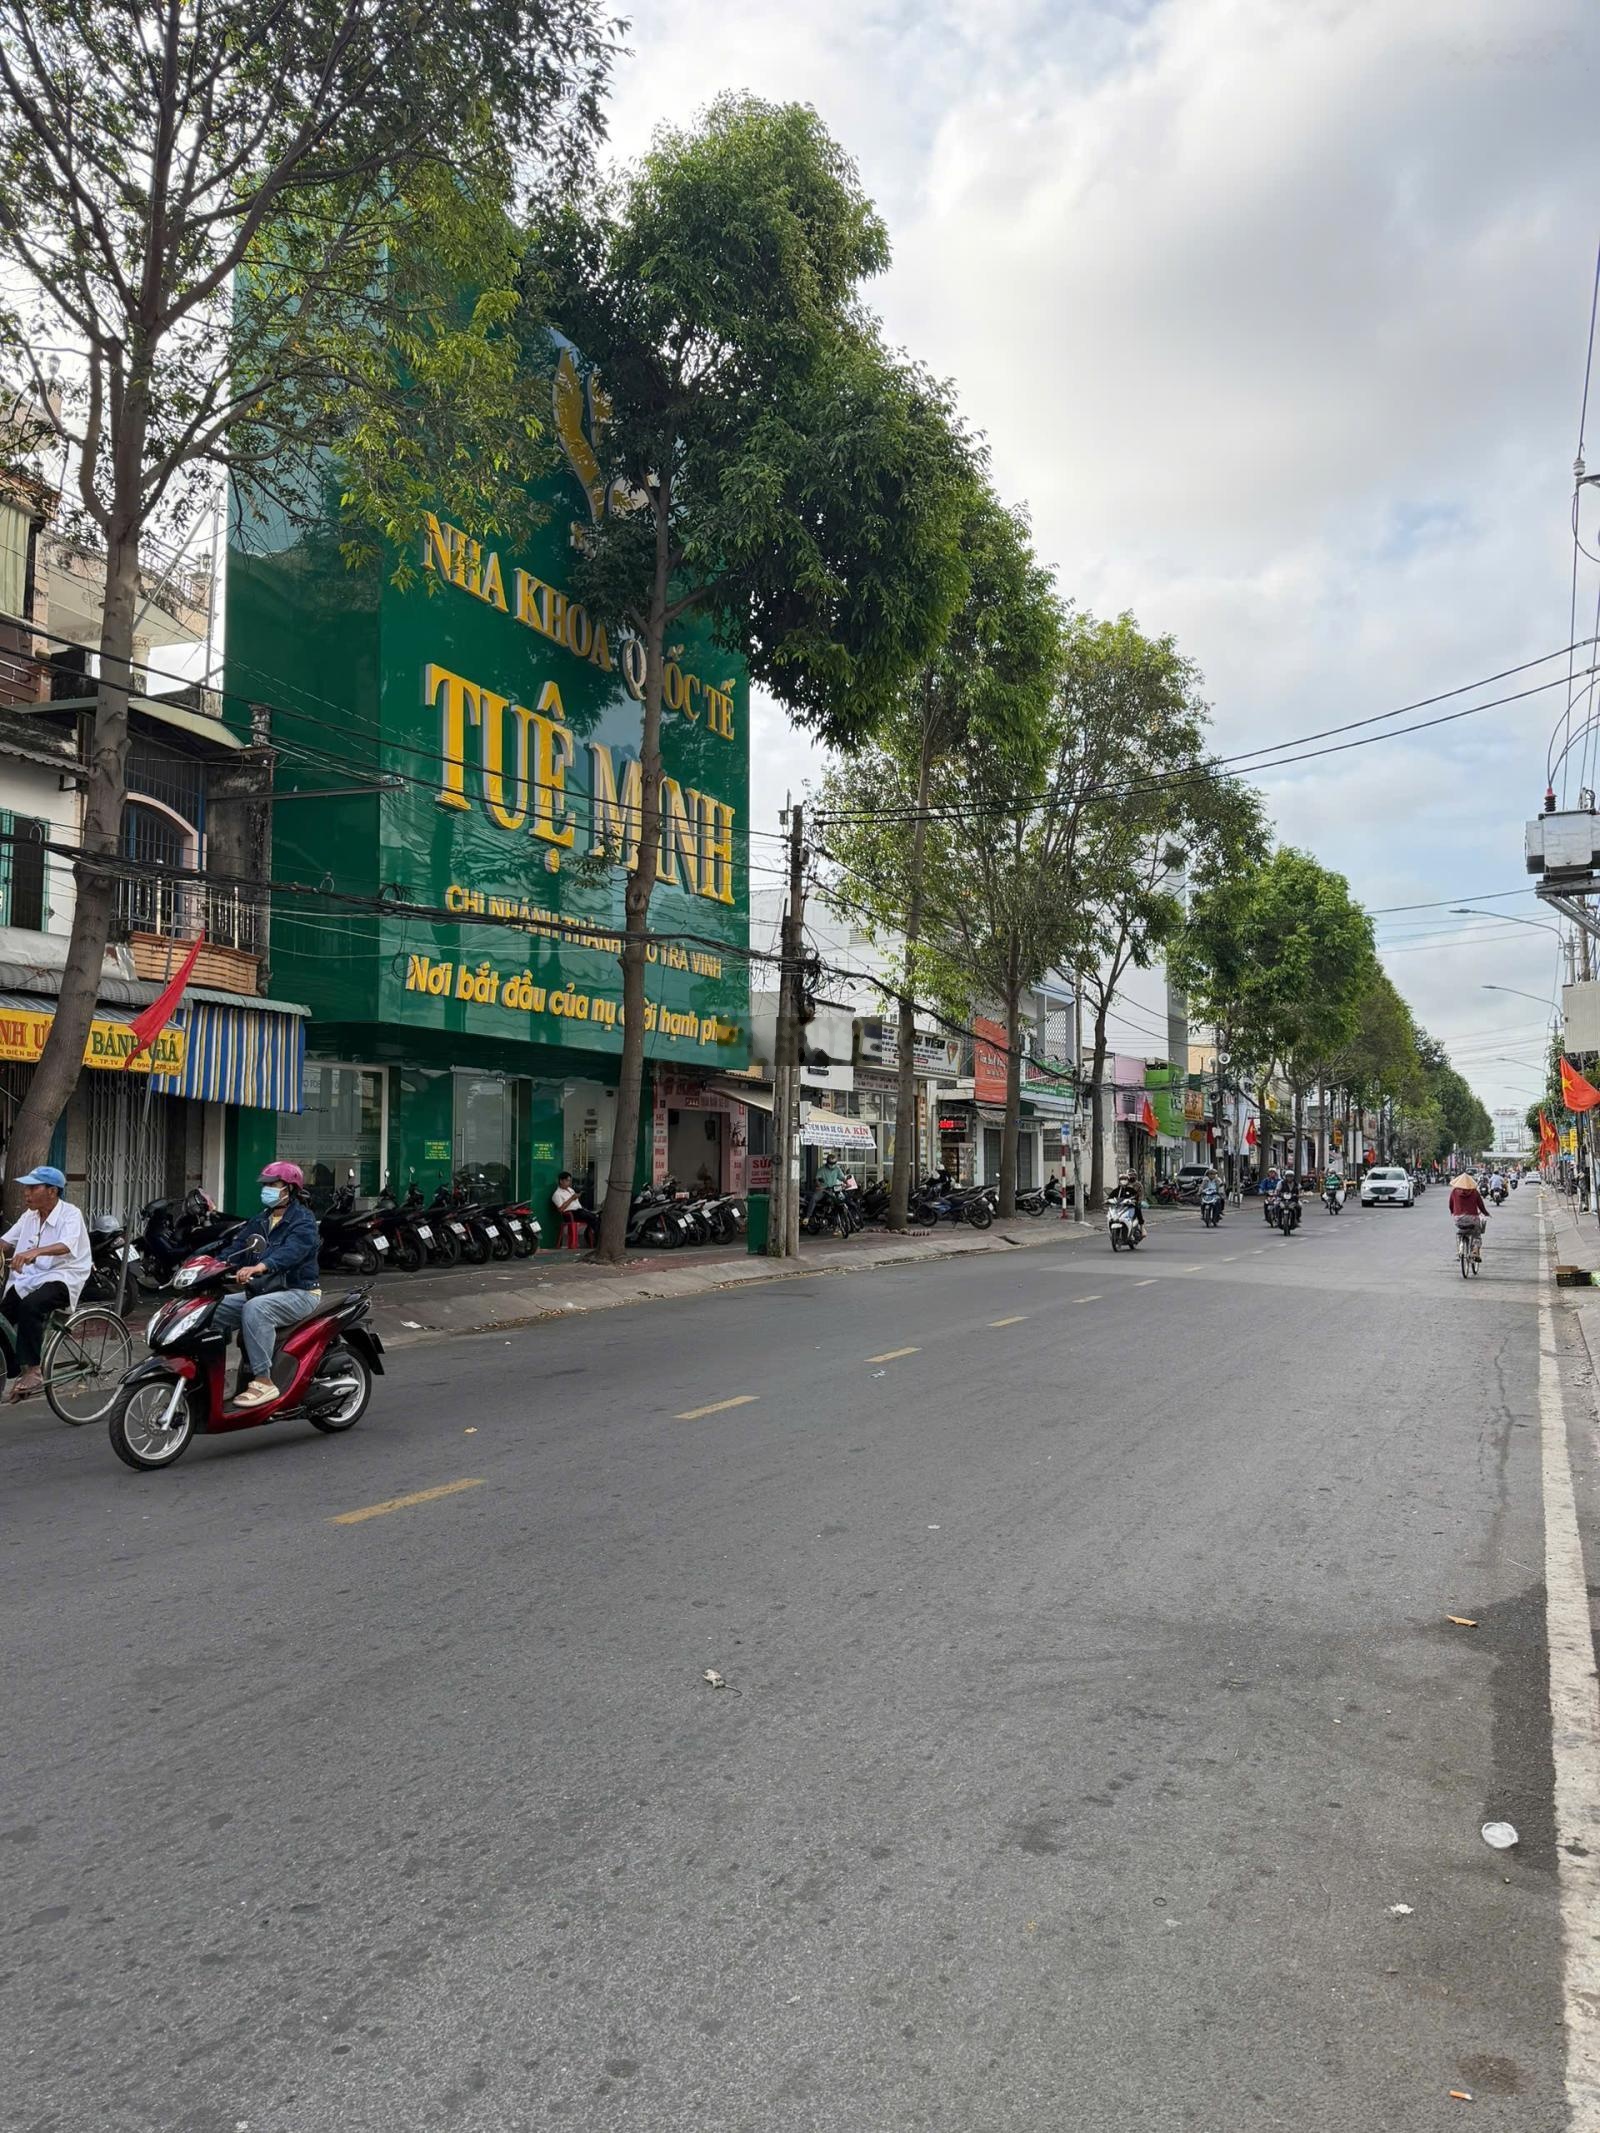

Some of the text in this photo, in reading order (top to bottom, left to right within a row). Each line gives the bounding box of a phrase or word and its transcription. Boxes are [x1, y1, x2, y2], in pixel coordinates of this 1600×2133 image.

[421, 511, 736, 740] NHA KHOA QỐC TẾ
[424, 663, 735, 905] TUỆ MNH
[405, 954, 453, 996] Nơi
[455, 960, 499, 1004] bắt
[502, 968, 546, 1012] đầu
[549, 982, 589, 1021] của
[591, 997, 616, 1032] nụ
[658, 1004, 699, 1042] hạnh
[660, 941, 690, 971] TRÀ
[690, 951, 722, 980] VINH
